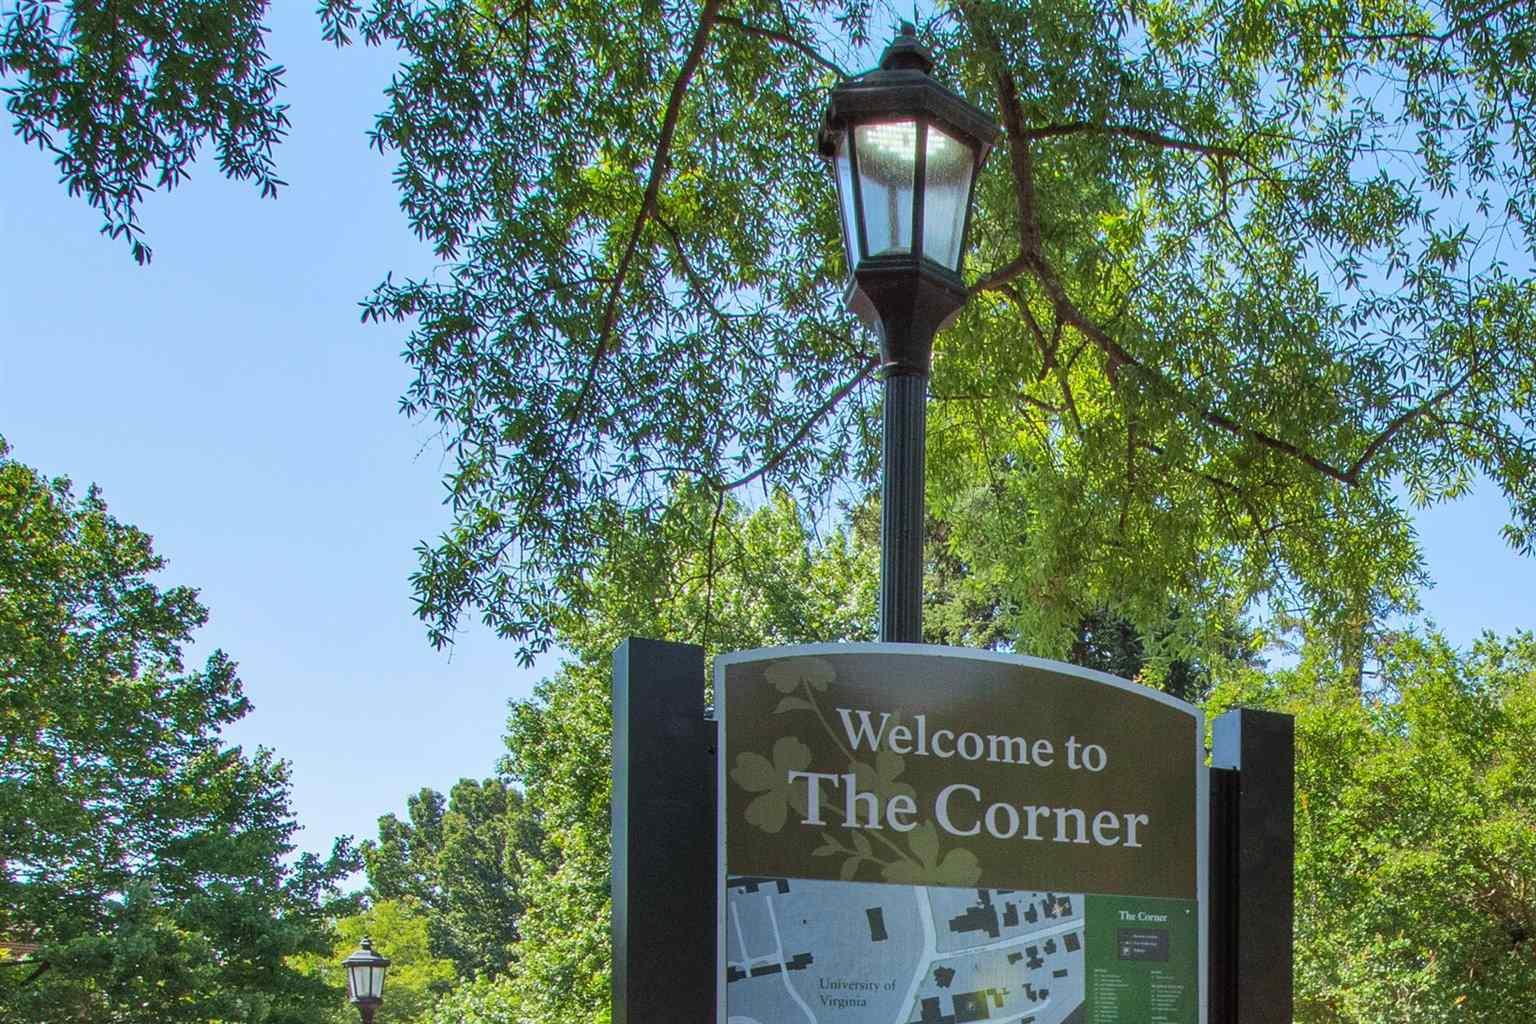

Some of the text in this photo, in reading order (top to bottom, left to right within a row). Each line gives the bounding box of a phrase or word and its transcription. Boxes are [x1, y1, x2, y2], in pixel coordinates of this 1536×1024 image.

[836, 708, 1108, 772] Welcome to
[788, 769, 1149, 848] The Corner
[1118, 910, 1168, 922] The Corner
[819, 978, 897, 991] University of
[819, 994, 867, 1009] Virginia
